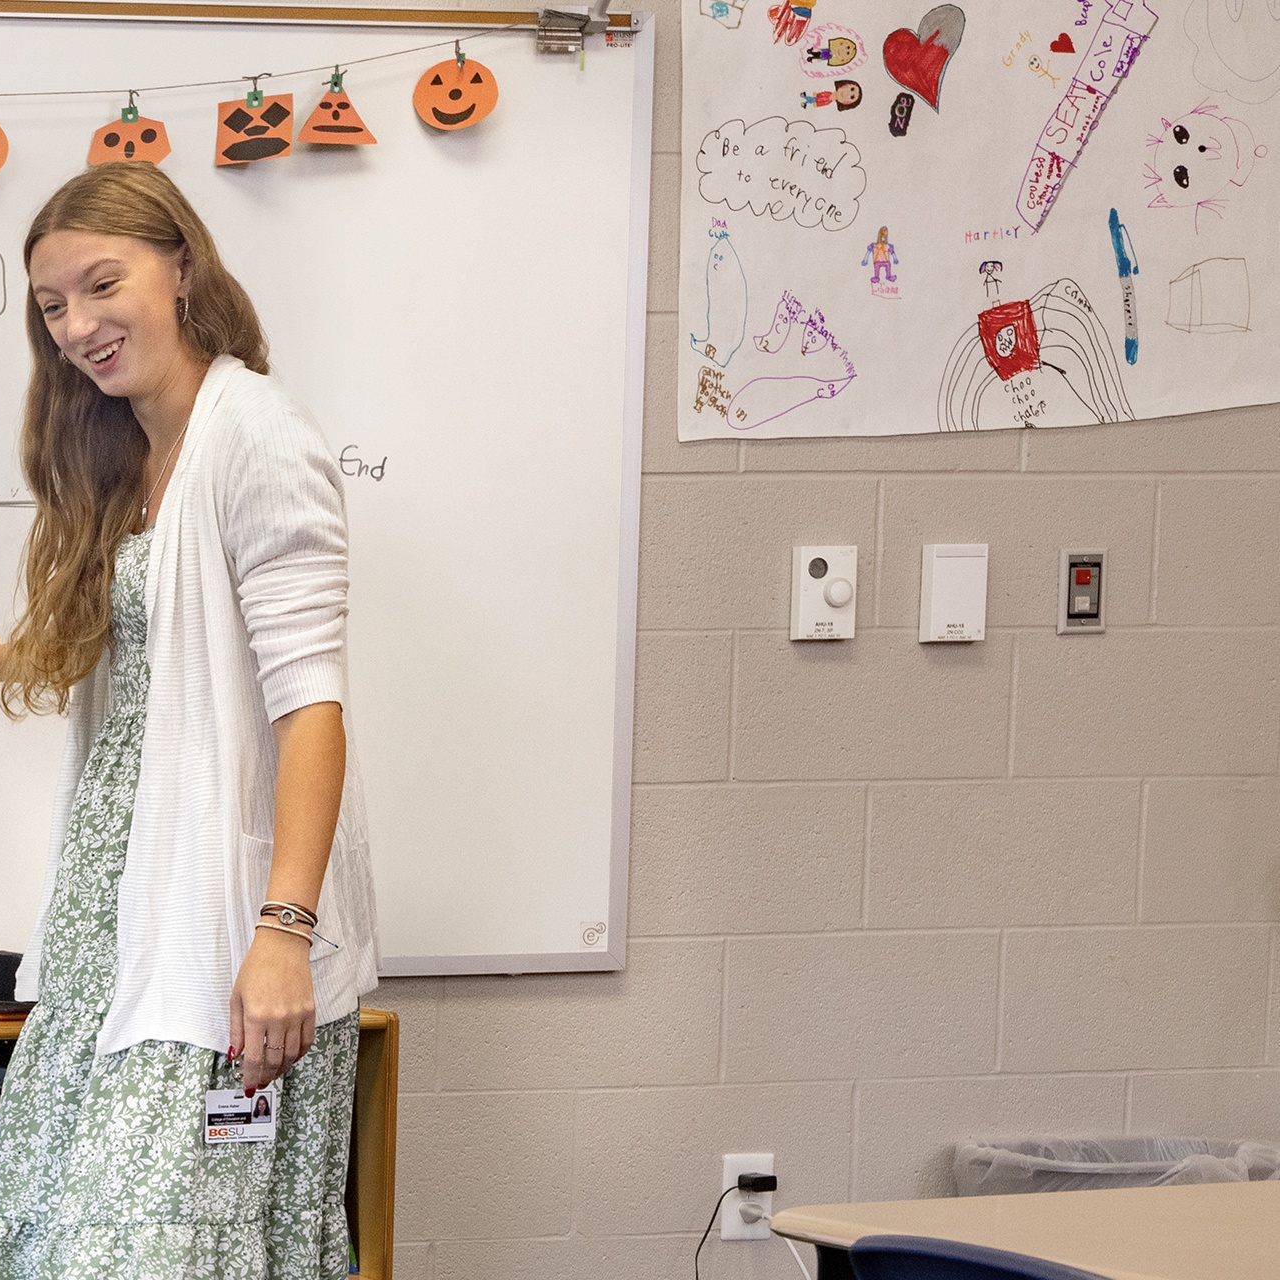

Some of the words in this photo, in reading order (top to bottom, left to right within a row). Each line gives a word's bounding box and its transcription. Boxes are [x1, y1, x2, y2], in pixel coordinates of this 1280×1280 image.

[1002, 30, 1033, 67] Grady
[1090, 35, 1112, 82] Cole
[722, 138, 740, 157] Be
[754, 144, 770, 156] a
[783, 137, 848, 179] friend
[737, 169, 752, 182] to
[769, 176, 843, 223] everyone
[711, 217, 728, 229] Dad
[338, 445, 388, 481] End
[208, 1127, 244, 1137] BGSU
